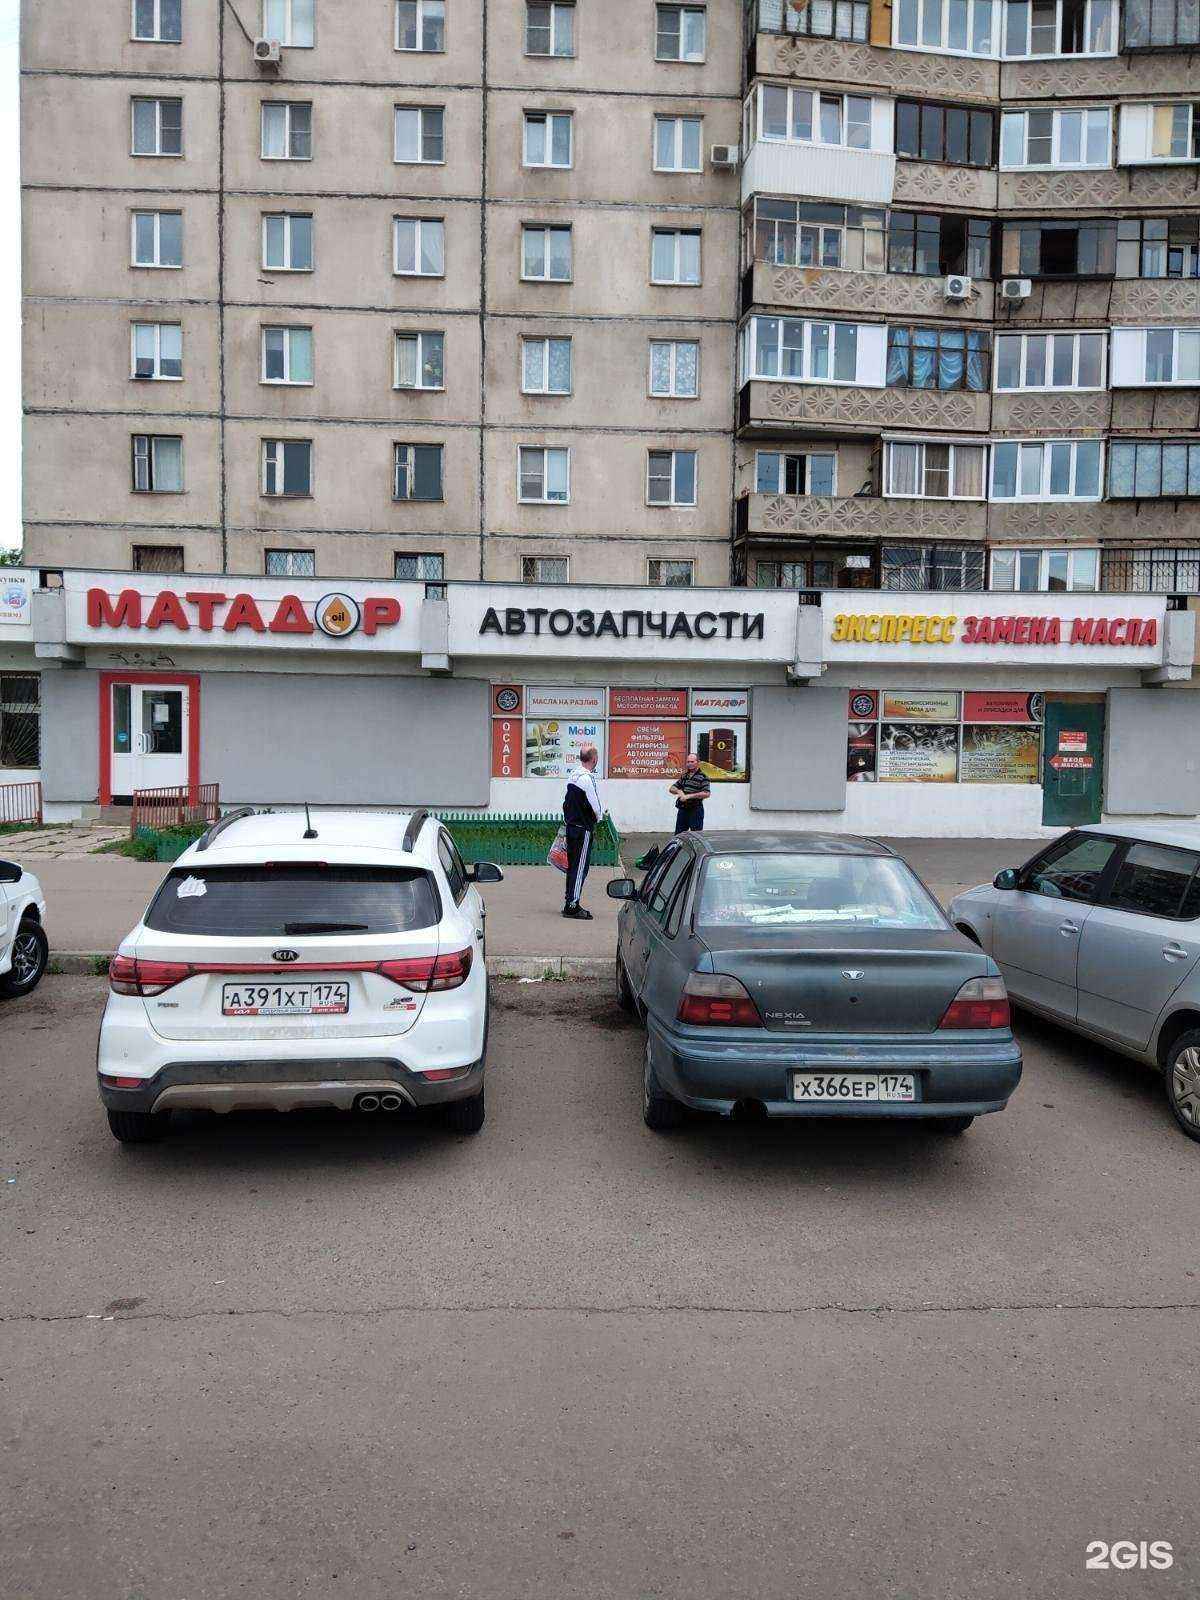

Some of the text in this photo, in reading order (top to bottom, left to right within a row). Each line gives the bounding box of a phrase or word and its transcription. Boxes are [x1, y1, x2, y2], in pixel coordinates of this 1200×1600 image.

[332, 611, 345, 622] oil
[479, 607, 764, 640] АВТОЗАПЧАСТИ
[831, 614, 1157, 647] ЭКСПРЕСС ЗАМЕНА МАСЛА
[694, 699, 746, 708] МАТАДОР
[568, 725, 597, 736] Mobil
[502, 722, 511, 775] ОСАГО
[545, 738, 561, 746] ZIC
[275, 951, 295, 961] KIA
[314, 985, 344, 1001] 174
[880, 1076, 910, 1092] 174
